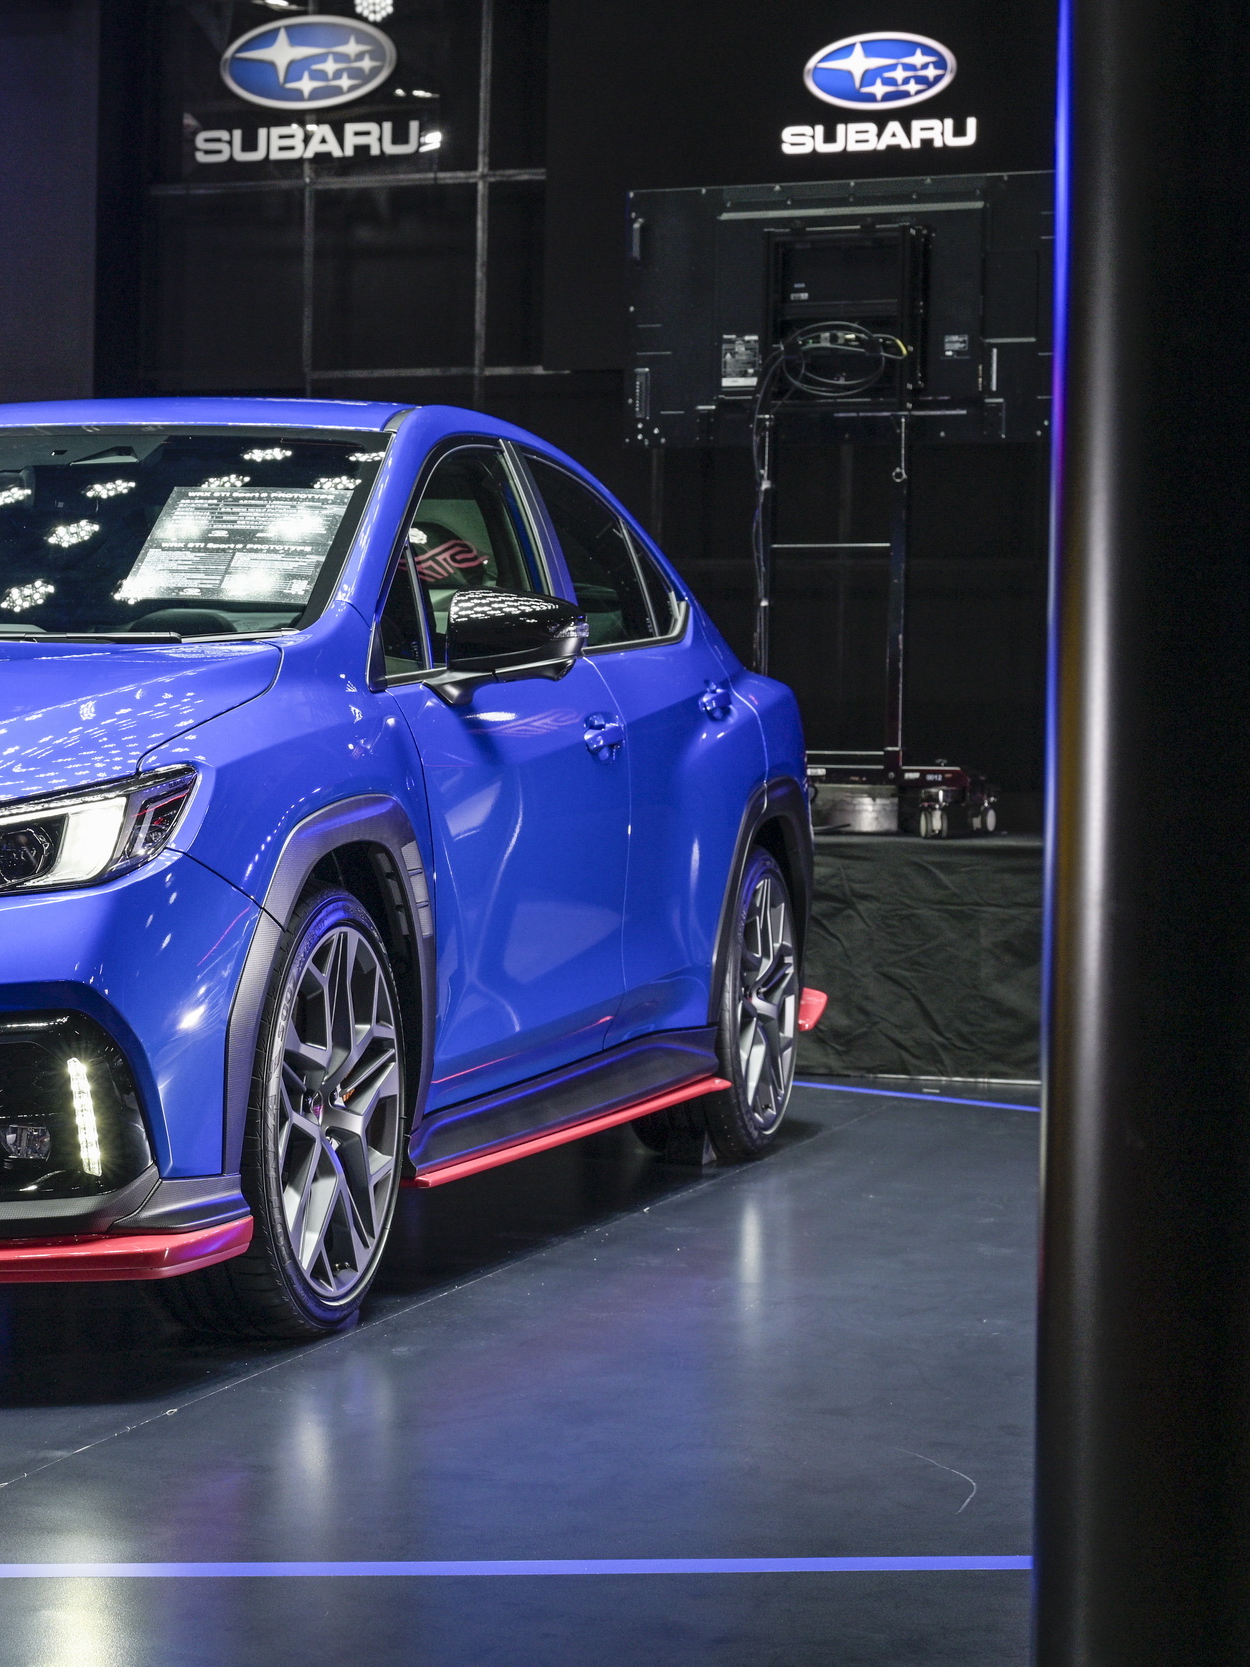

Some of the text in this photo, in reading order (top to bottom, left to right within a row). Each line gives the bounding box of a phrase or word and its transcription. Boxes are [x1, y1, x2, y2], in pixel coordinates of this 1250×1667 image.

[194, 120, 420, 164] SUBARU
[781, 116, 977, 155] SUBARU
[246, 543, 312, 552] PROTOTYPE
